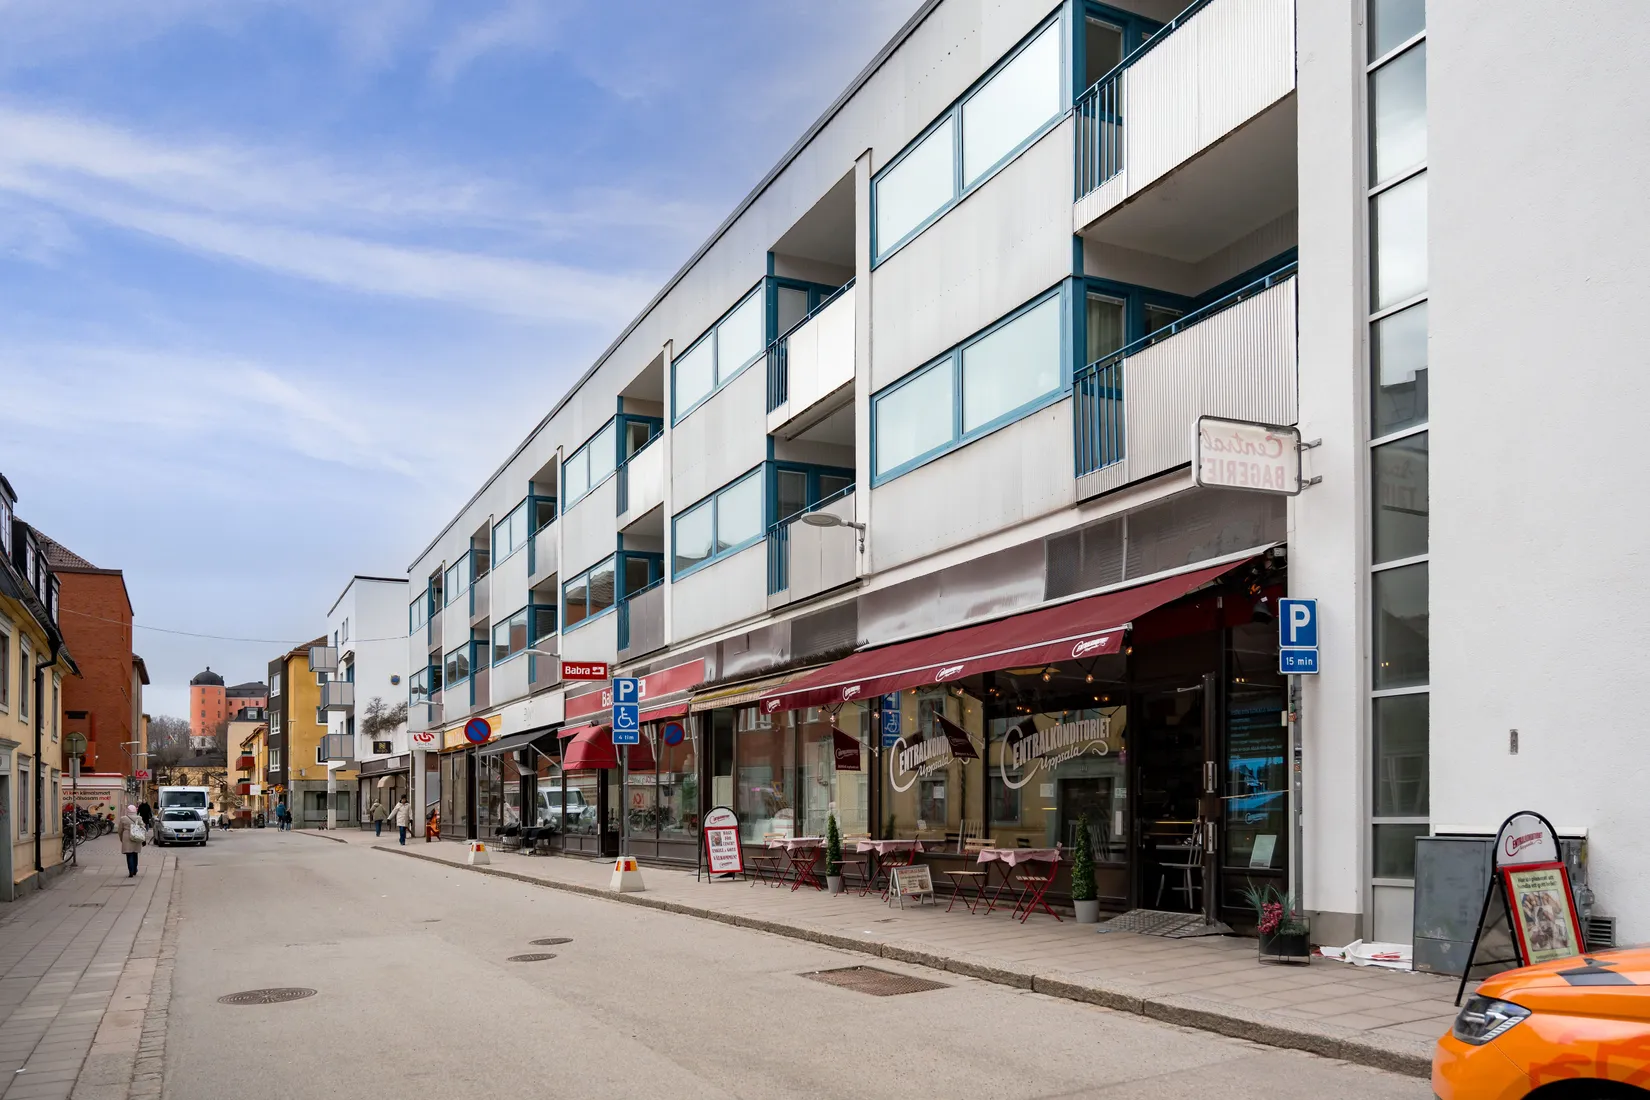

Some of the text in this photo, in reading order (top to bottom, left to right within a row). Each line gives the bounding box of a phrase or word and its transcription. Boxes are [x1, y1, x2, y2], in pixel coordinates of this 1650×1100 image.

[1289, 604, 1310, 642] P
[564, 665, 591, 676] Babra
[1285, 656, 1313, 666] 15 min
[619, 680, 634, 701] P
[1000, 717, 1111, 789] CENTRALKONDITORIET
[1038, 743, 1081, 772] Uppsala
[135, 769, 149, 777] ICA
[918, 755, 950, 778] Uppsala
